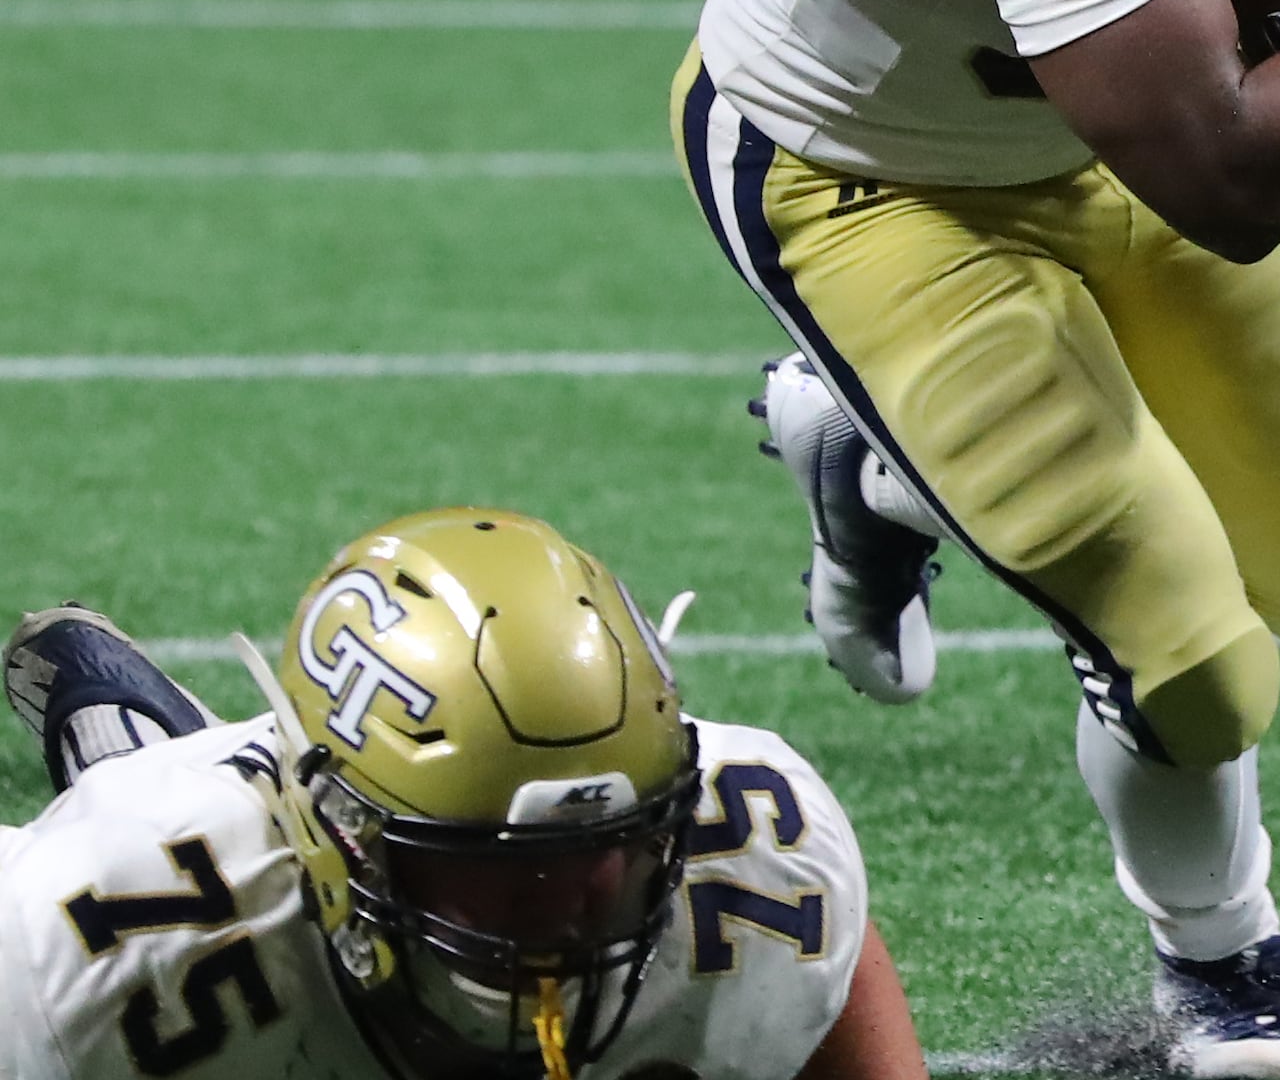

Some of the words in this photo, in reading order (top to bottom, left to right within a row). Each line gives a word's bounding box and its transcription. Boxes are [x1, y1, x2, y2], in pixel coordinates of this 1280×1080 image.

[297, 568, 437, 751] GT
[58, 834, 290, 1080] 75
[687, 758, 827, 978] 75
